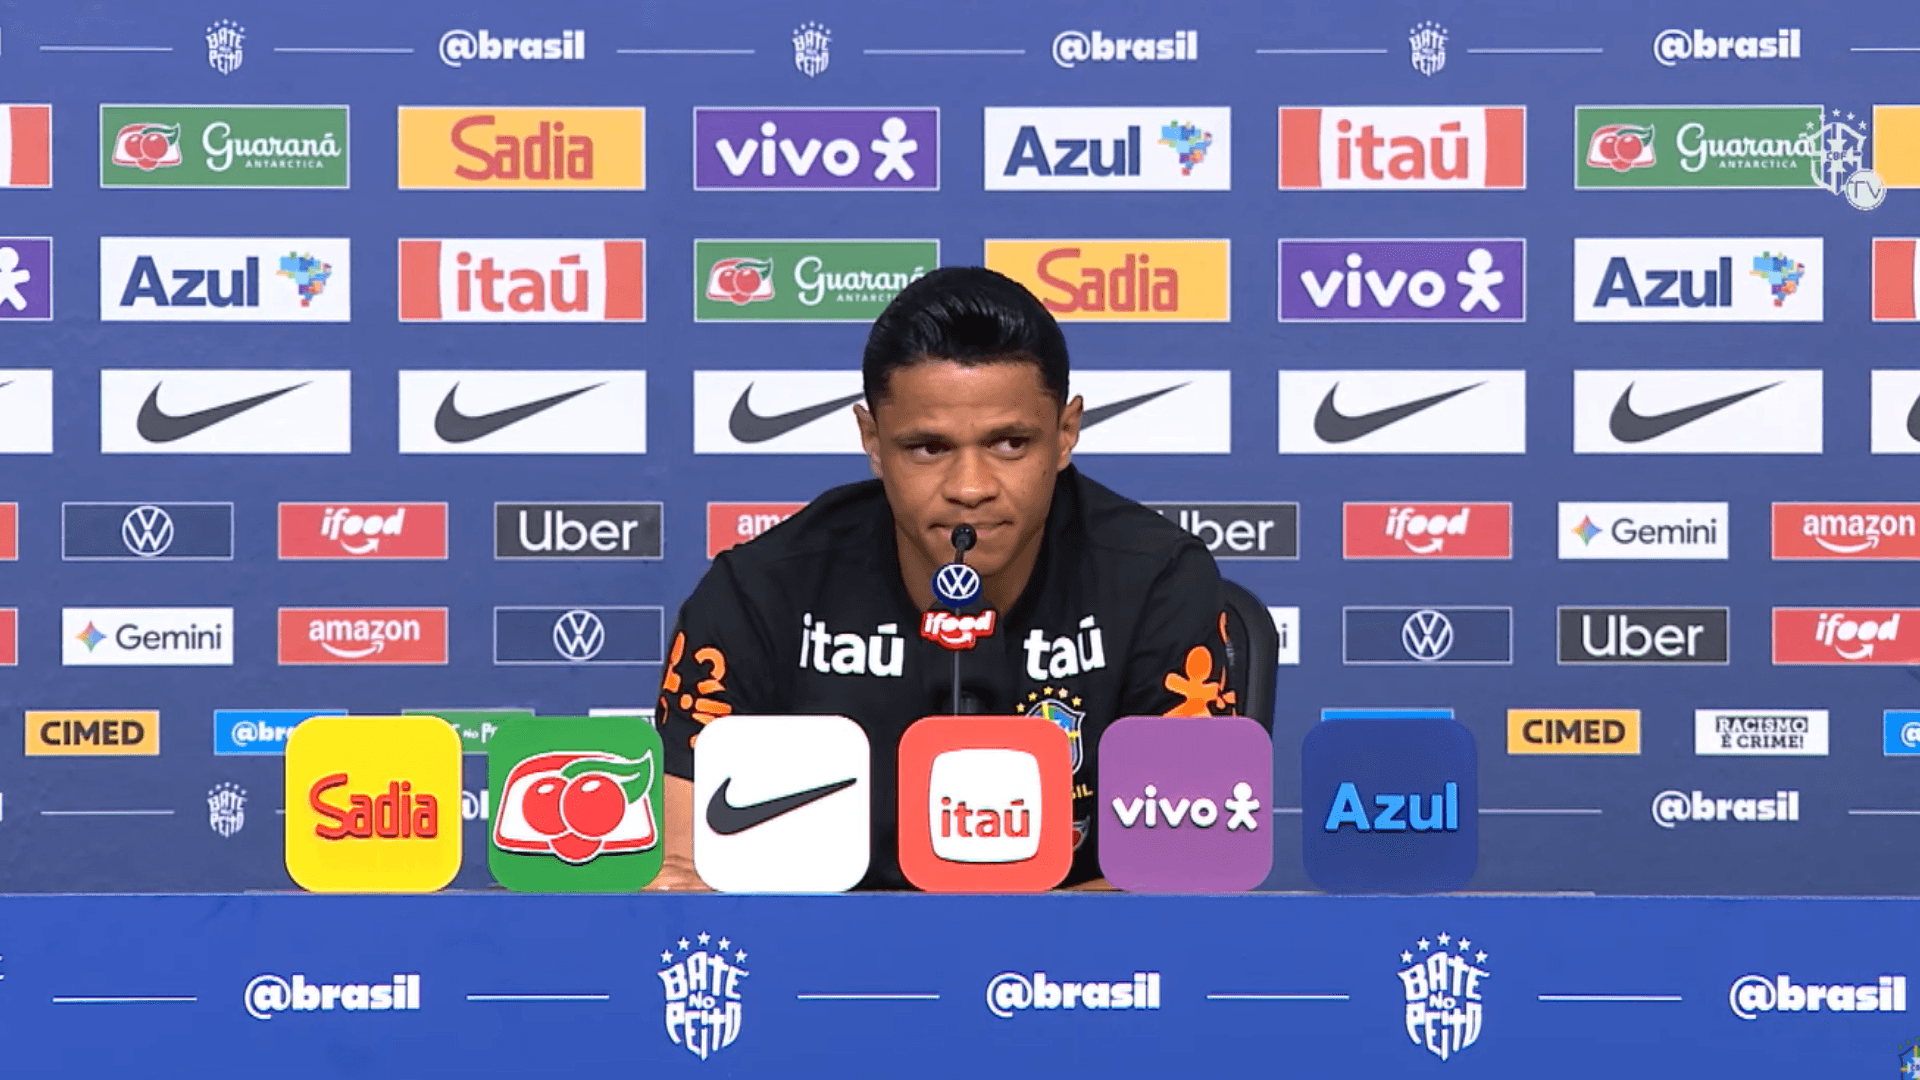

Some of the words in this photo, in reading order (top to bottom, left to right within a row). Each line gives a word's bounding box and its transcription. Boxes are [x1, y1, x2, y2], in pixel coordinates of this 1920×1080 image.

[440, 30, 585, 67] @brasil
[1053, 31, 1198, 67] @brasil
[1654, 29, 1801, 65] @brasil
[203, 121, 342, 172] Guaraná
[245, 159, 324, 169] ANTARCTICA
[451, 115, 593, 180] Sadia
[716, 121, 860, 177] vivo
[1003, 126, 1141, 177] Azul
[1336, 119, 1469, 180] itaú
[1677, 122, 1813, 172] Guaraná
[1718, 159, 1798, 169] ANTARCTICA
[120, 256, 259, 307] Azul
[457, 252, 589, 312] itaú
[1037, 248, 1178, 313] Sadia
[1300, 253, 1446, 308] vivo
[1594, 257, 1733, 307] Azul
[321, 508, 405, 537] ifood
[519, 510, 639, 552] Uber
[1385, 508, 1470, 537] ifood
[1611, 518, 1717, 545] Gemini
[1803, 514, 1916, 536] amazon
[116, 624, 222, 650] Gemini
[309, 619, 420, 642] amazon
[924, 610, 995, 635] ifood
[1582, 615, 1704, 657] Uber
[1815, 612, 1901, 646] ifood
[799, 612, 905, 677] itaú
[1023, 614, 1106, 681] taú
[40, 720, 145, 746] CIMED
[1522, 719, 1626, 744] CIMED
[1717, 716, 1808, 733] RACISMO
[1736, 734, 1804, 749] CRIME!
[309, 774, 438, 840] Sadia
[941, 797, 1030, 838] itaú
[1112, 785, 1217, 829] vivo
[1326, 783, 1458, 833] Azul
[1653, 791, 1799, 827] @brasil
[245, 974, 420, 1020] @brasil
[658, 951, 749, 1000] BATE
[986, 972, 1161, 1018] @brasil
[1397, 951, 1490, 1000] BATE
[1729, 974, 1907, 1020] @brasil
